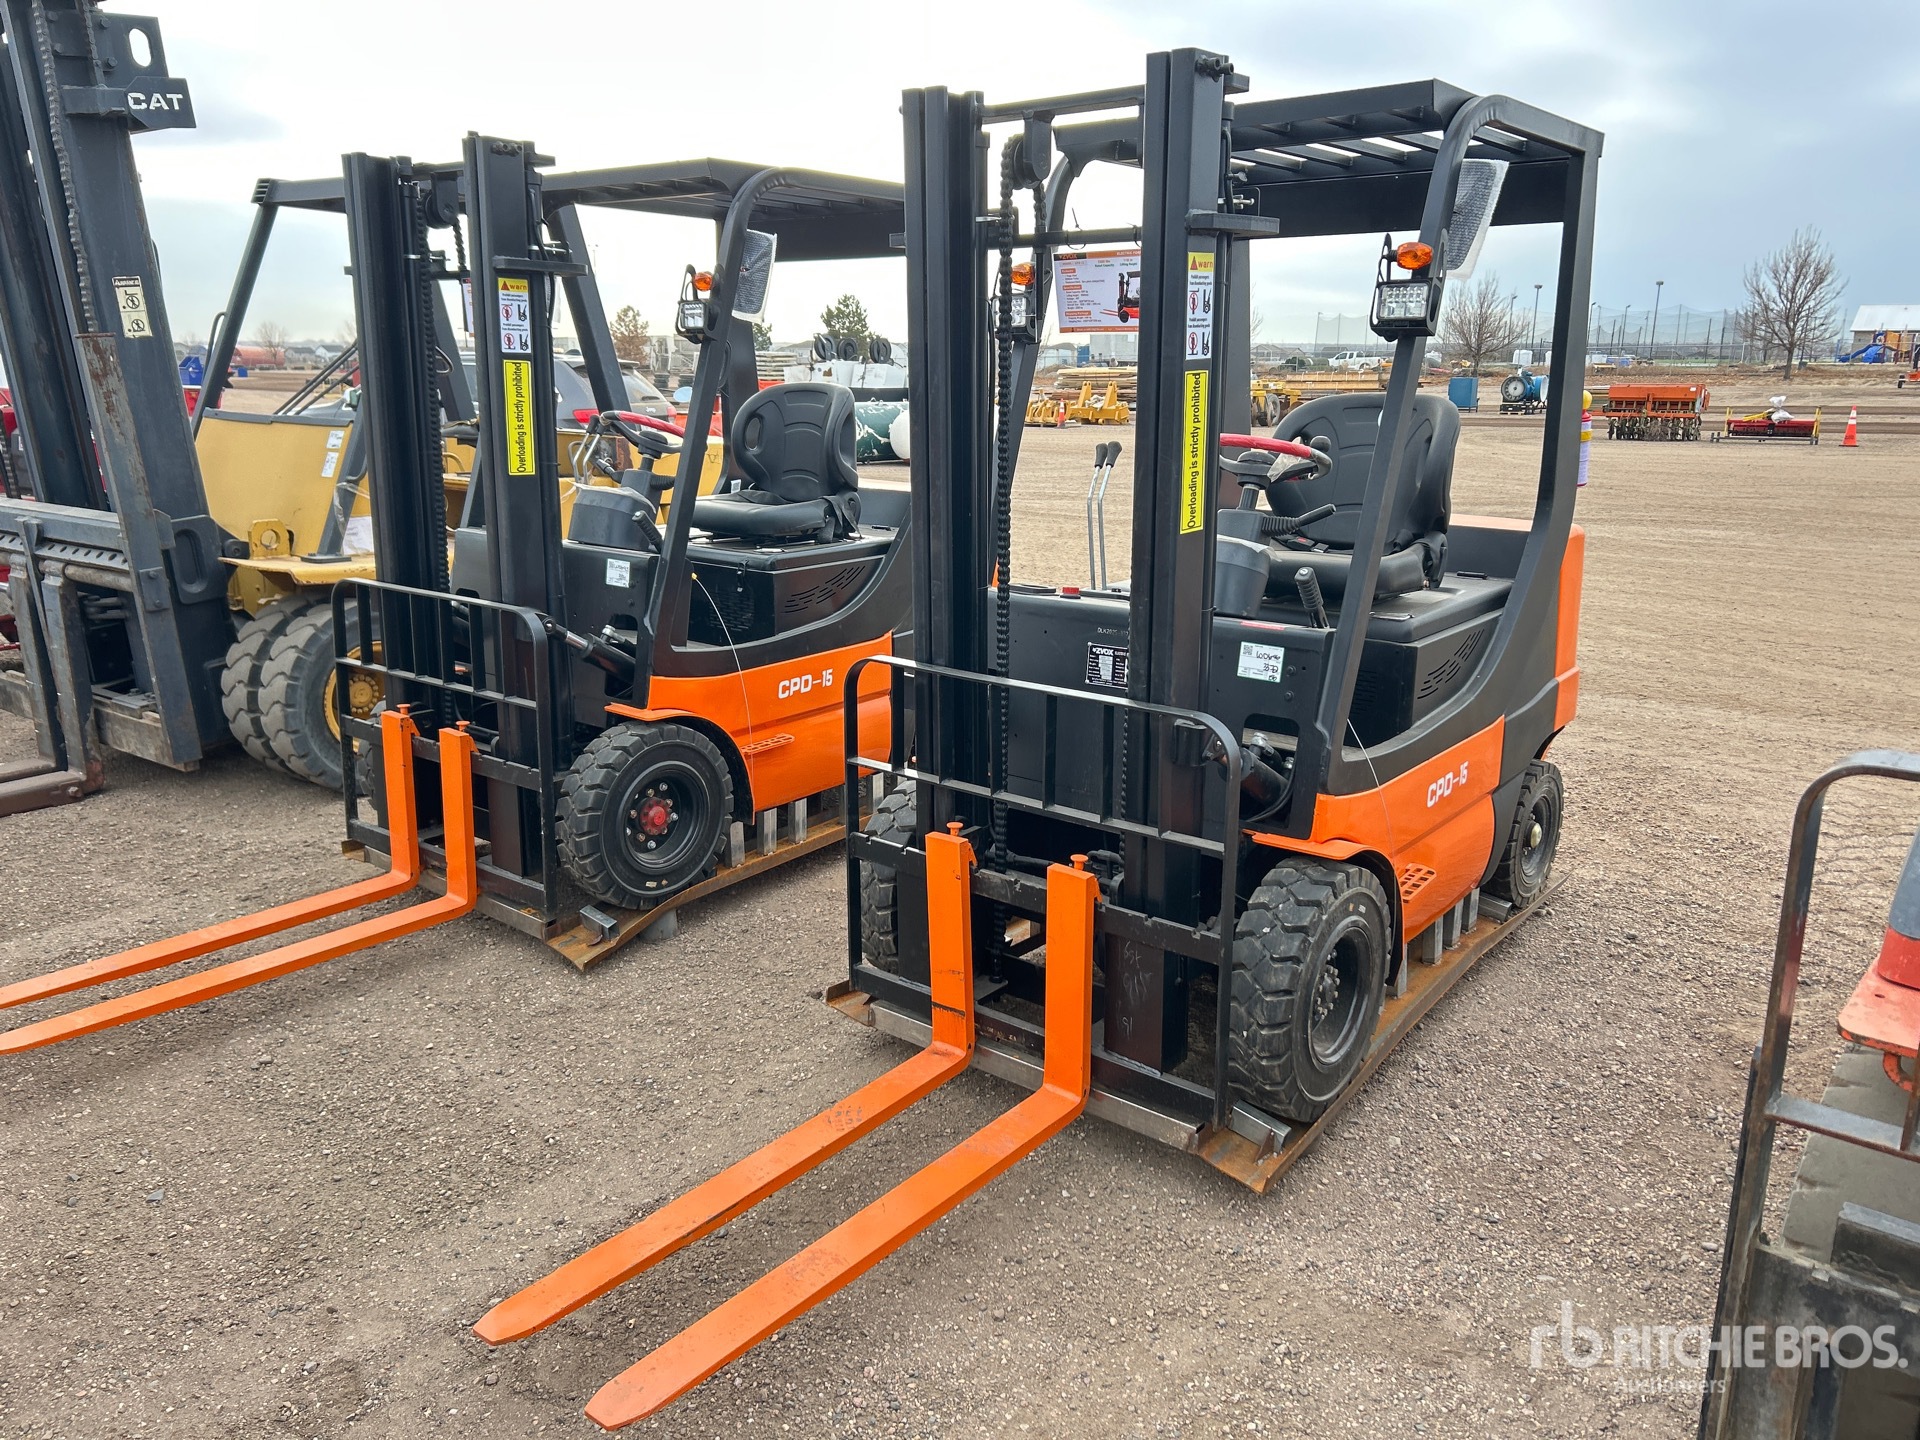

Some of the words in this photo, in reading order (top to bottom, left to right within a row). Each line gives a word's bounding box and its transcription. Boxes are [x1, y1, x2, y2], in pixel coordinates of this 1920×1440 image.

[127, 92, 183, 110] CAT
[512, 362, 525, 398] prohibited
[514, 400, 525, 423] strictly
[1191, 373, 1201, 423] prohibited
[516, 431, 527, 473] Overloading
[1190, 426, 1200, 459] strictly
[1189, 460, 1198, 469] is
[1187, 471, 1200, 529] Overloading
[1095, 648, 1114, 656] ZVOX
[778, 668, 833, 699] CPD-15
[1427, 761, 1468, 808] CPD-15
